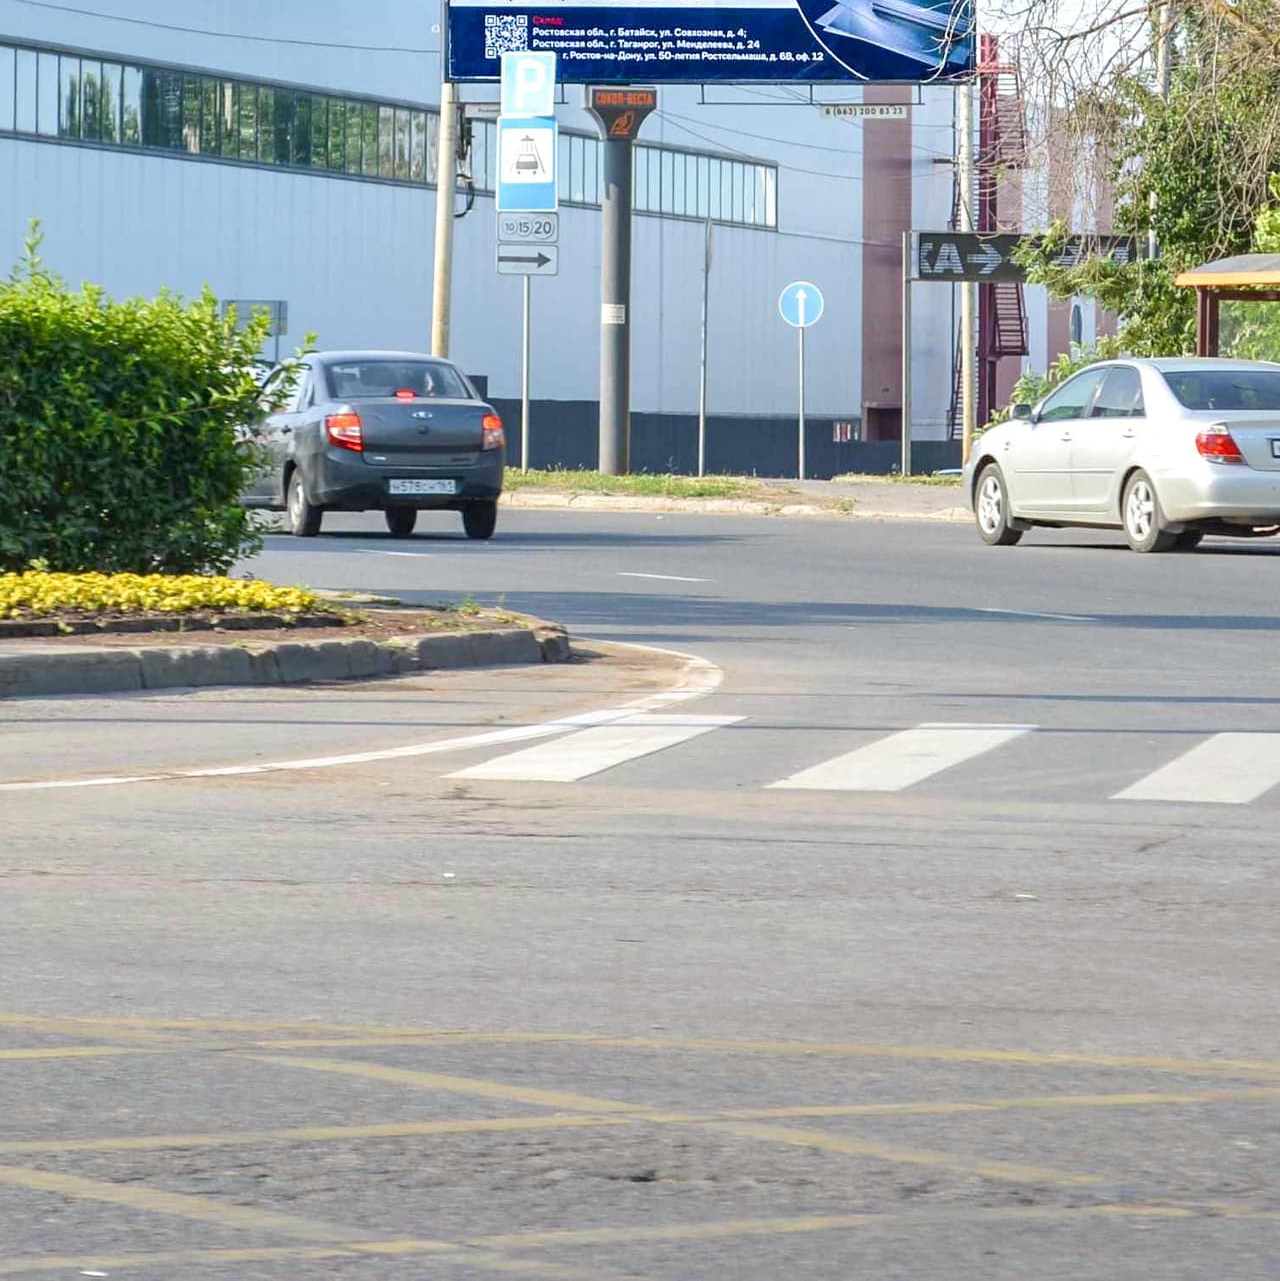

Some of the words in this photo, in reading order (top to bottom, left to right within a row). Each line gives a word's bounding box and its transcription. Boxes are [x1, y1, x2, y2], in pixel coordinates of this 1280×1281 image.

[532, 27, 586, 37] Ростовская
[532, 39, 586, 49] Ростовская
[812, 51, 824, 62] 12
[519, 221, 530, 233] 15
[534, 221, 552, 234] 20
